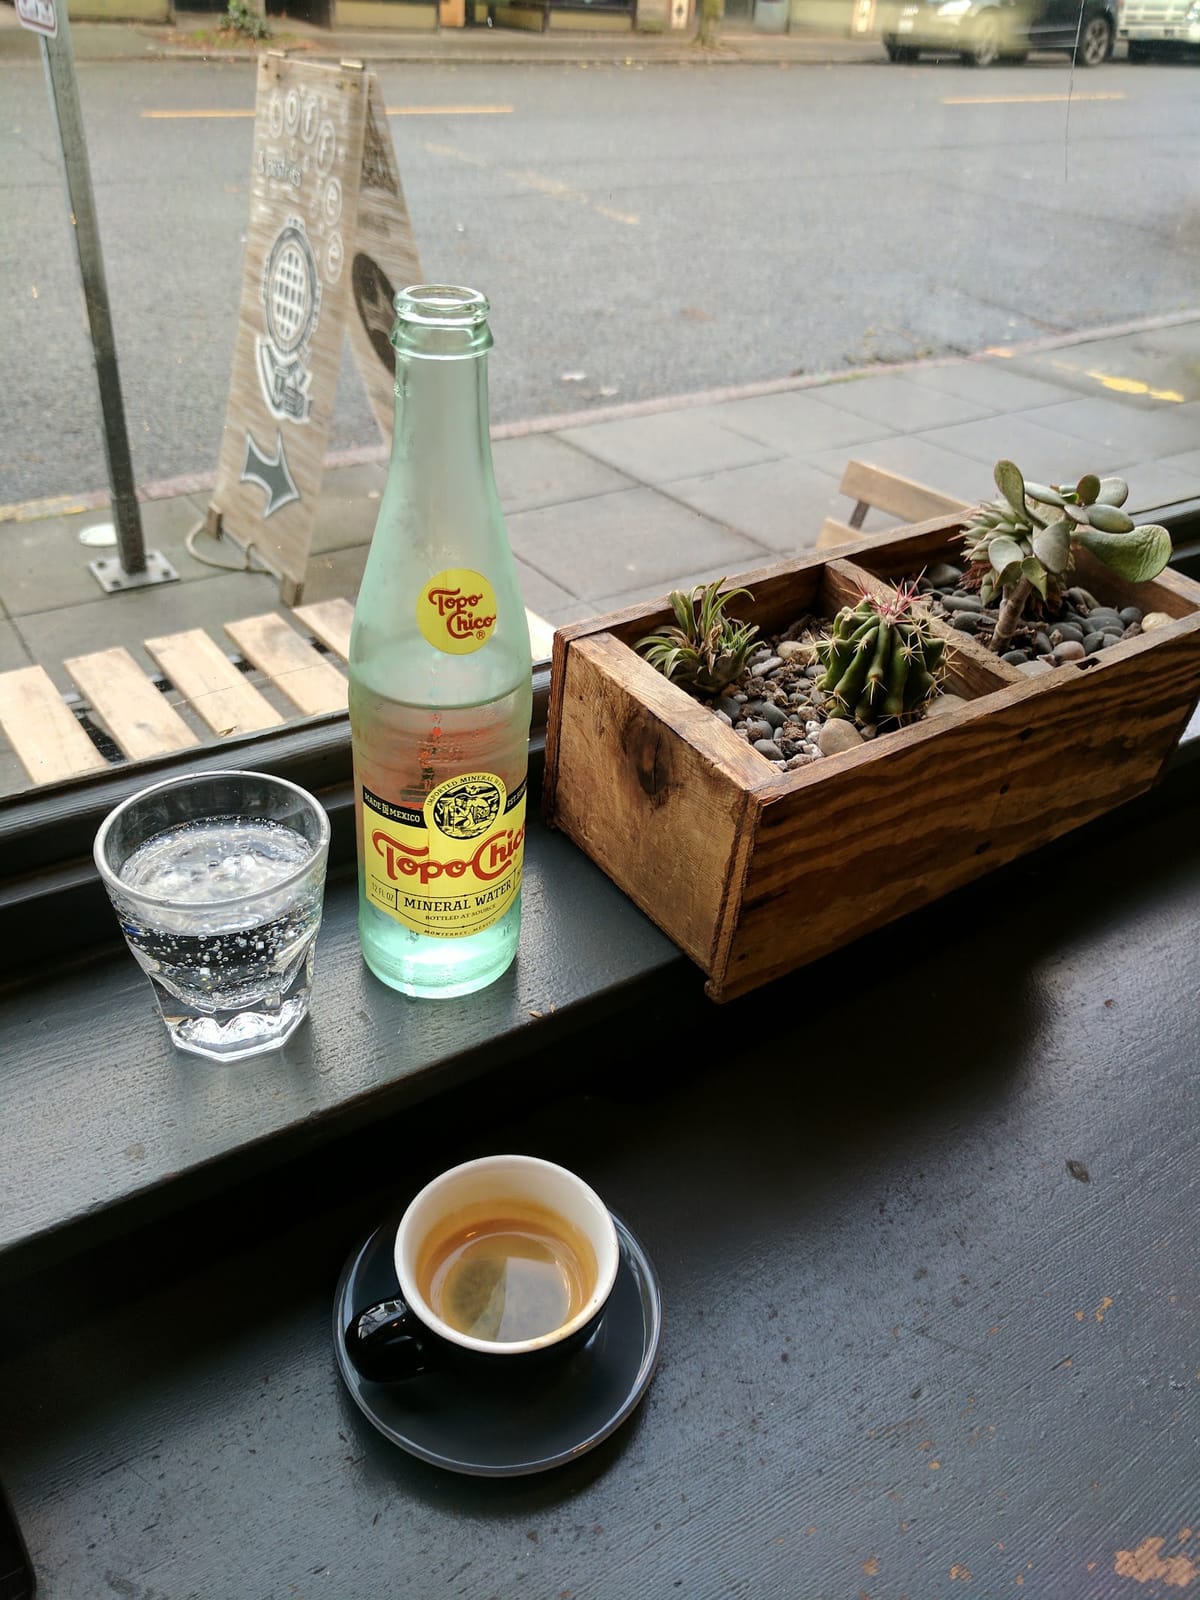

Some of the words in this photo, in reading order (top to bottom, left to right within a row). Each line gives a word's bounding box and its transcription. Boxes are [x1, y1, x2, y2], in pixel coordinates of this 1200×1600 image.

[428, 587, 483, 616] Topo
[446, 611, 497, 640] Chico
[364, 792, 381, 810] MADE
[389, 808, 421, 823] MEXICO
[426, 779, 458, 807] IMPORTED
[371, 828, 469, 884] Topo
[470, 823, 525, 881] Chic
[404, 897, 471, 912] MINERAL
[475, 879, 511, 906] WATER
[470, 904, 496, 918] SOURCE
